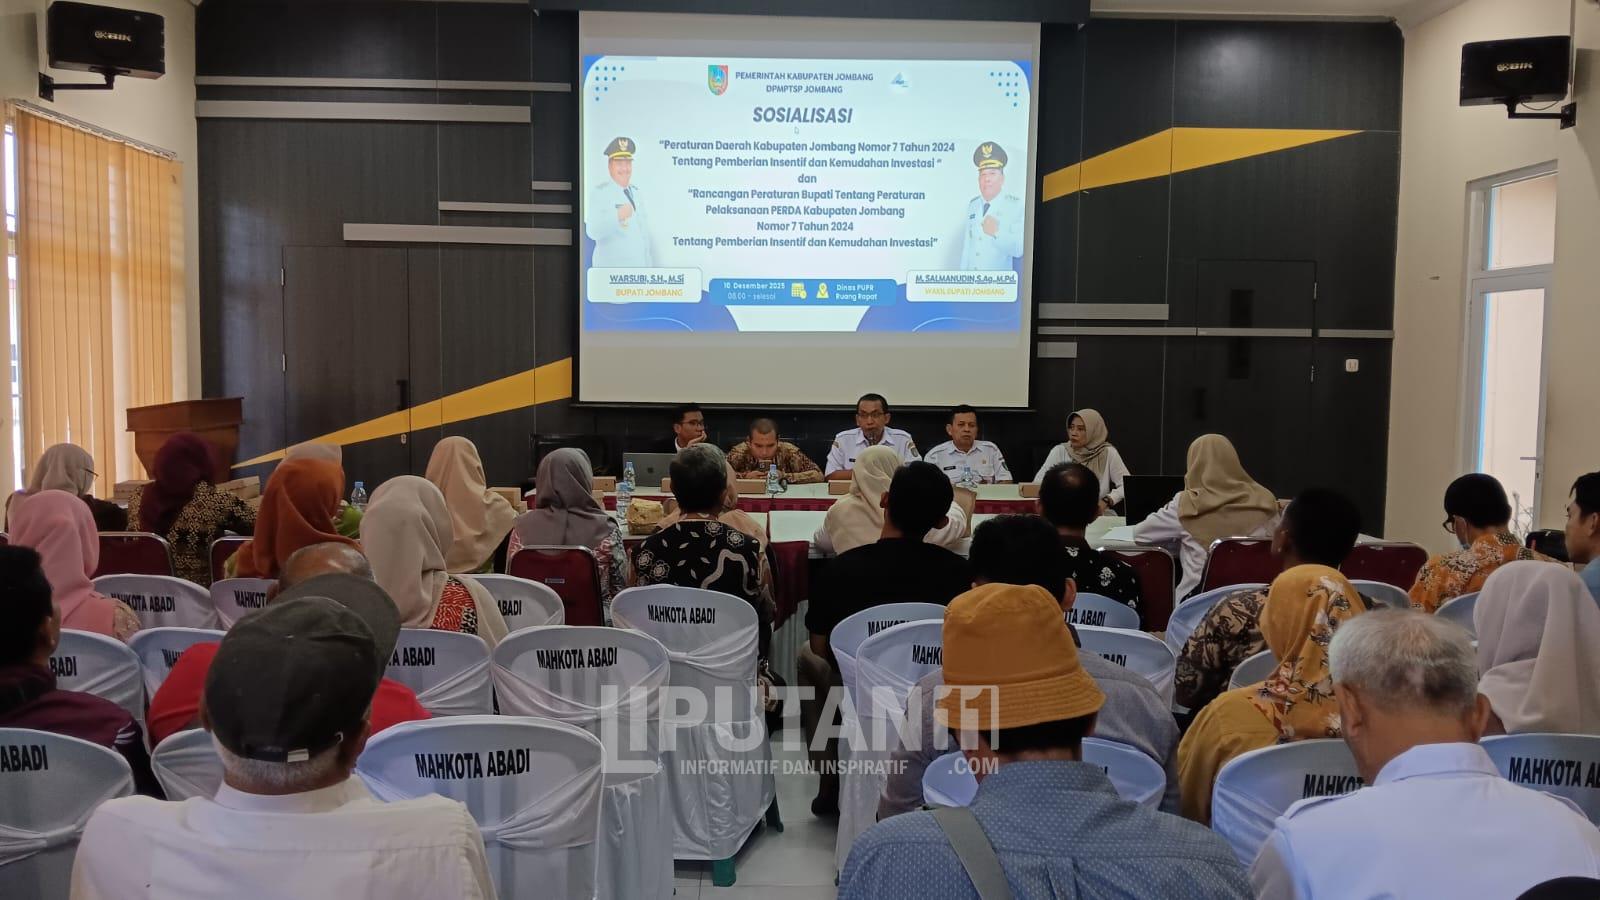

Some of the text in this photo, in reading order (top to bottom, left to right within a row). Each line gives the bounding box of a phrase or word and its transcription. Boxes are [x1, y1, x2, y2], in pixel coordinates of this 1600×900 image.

[735, 72, 874, 82] PEMERINTAH KABUPATEN JOMBANG
[766, 85, 843, 94] DPMPTSP JOMBANG
[752, 106, 853, 124] SOSIALISASI
[715, 140, 752, 151] Daerah
[753, 141, 808, 154] Kabupaten
[809, 142, 856, 154] Jombang
[858, 142, 891, 151] Nomor
[892, 142, 898, 151] 7
[900, 142, 930, 152] Tahun
[932, 143, 955, 152] 2024
[672, 156, 713, 169] Tentang
[715, 157, 768, 167] Pemberian
[770, 157, 807, 167] Insentif
[808, 158, 827, 168] dan
[829, 158, 889, 168] Kemudahan
[891, 158, 935, 168] Investasi
[797, 173, 817, 183] dan
[751, 190, 799, 199] Peraturan
[801, 190, 833, 202] Bupati
[835, 190, 875, 202] Tentang
[877, 190, 925, 200] Peraturan
[705, 205, 905, 218] Pelaksanaan PERDA Kabupaten Jombang
[757, 221, 854, 231] Nomor 7 Tahun 2024
[673, 236, 713, 249] Tentang
[715, 237, 768, 247] Pemberian
[770, 237, 807, 247] Insentif
[807, 237, 827, 247] dan
[828, 237, 888, 248] Kemudahan
[668, 274, 685, 284] M.Si
[616, 288, 683, 297] BUPATI JOMBANG
[836, 293, 878, 301] Ruang Rapat
[925, 288, 946, 296] WAKIL
[947, 288, 971, 296] BUPATI
[150, 596, 176, 612] ABADI
[234, 590, 269, 608] MAHKOT
[648, 604, 715, 624] MAHKOTA ABADI
[1080, 609, 1106, 626] ABADI
[403, 647, 435, 666] ABADI
[537, 647, 617, 669] MAHKOTA ABADI
[912, 645, 943, 665] MAHK
[49, 656, 77, 677] BADI
[0, 744, 48, 772] ABADI
[415, 748, 530, 779] MAHKOTA ABADI
[1509, 756, 1581, 788] MAHKOTA
[1303, 774, 1365, 799] MAHKOT
